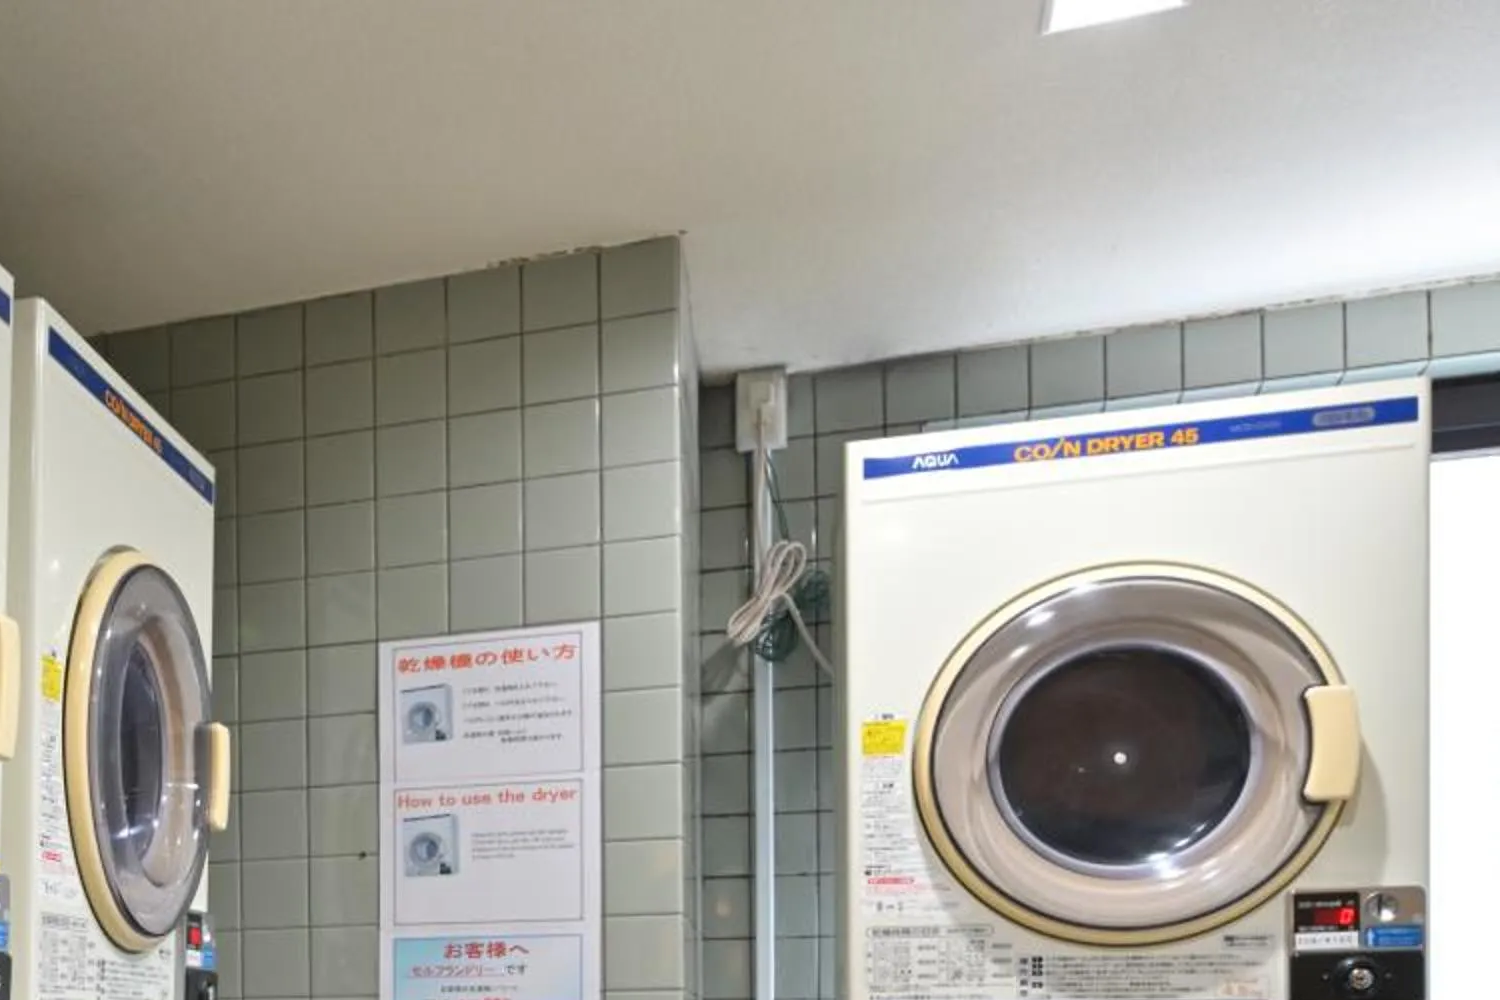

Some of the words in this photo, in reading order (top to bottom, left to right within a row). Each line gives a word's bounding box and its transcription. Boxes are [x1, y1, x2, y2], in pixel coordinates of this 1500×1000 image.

[912, 453, 959, 469] AQUA
[1087, 431, 1164, 457] DRYER
[1171, 428, 1199, 445] 45
[398, 643, 577, 673] 乾燥機の使い方
[398, 794, 432, 809] How
[439, 791, 456, 807] to
[461, 793, 492, 805] use
[498, 788, 525, 804] the
[531, 785, 577, 805] dryer
[443, 942, 530, 960] お客様へ
